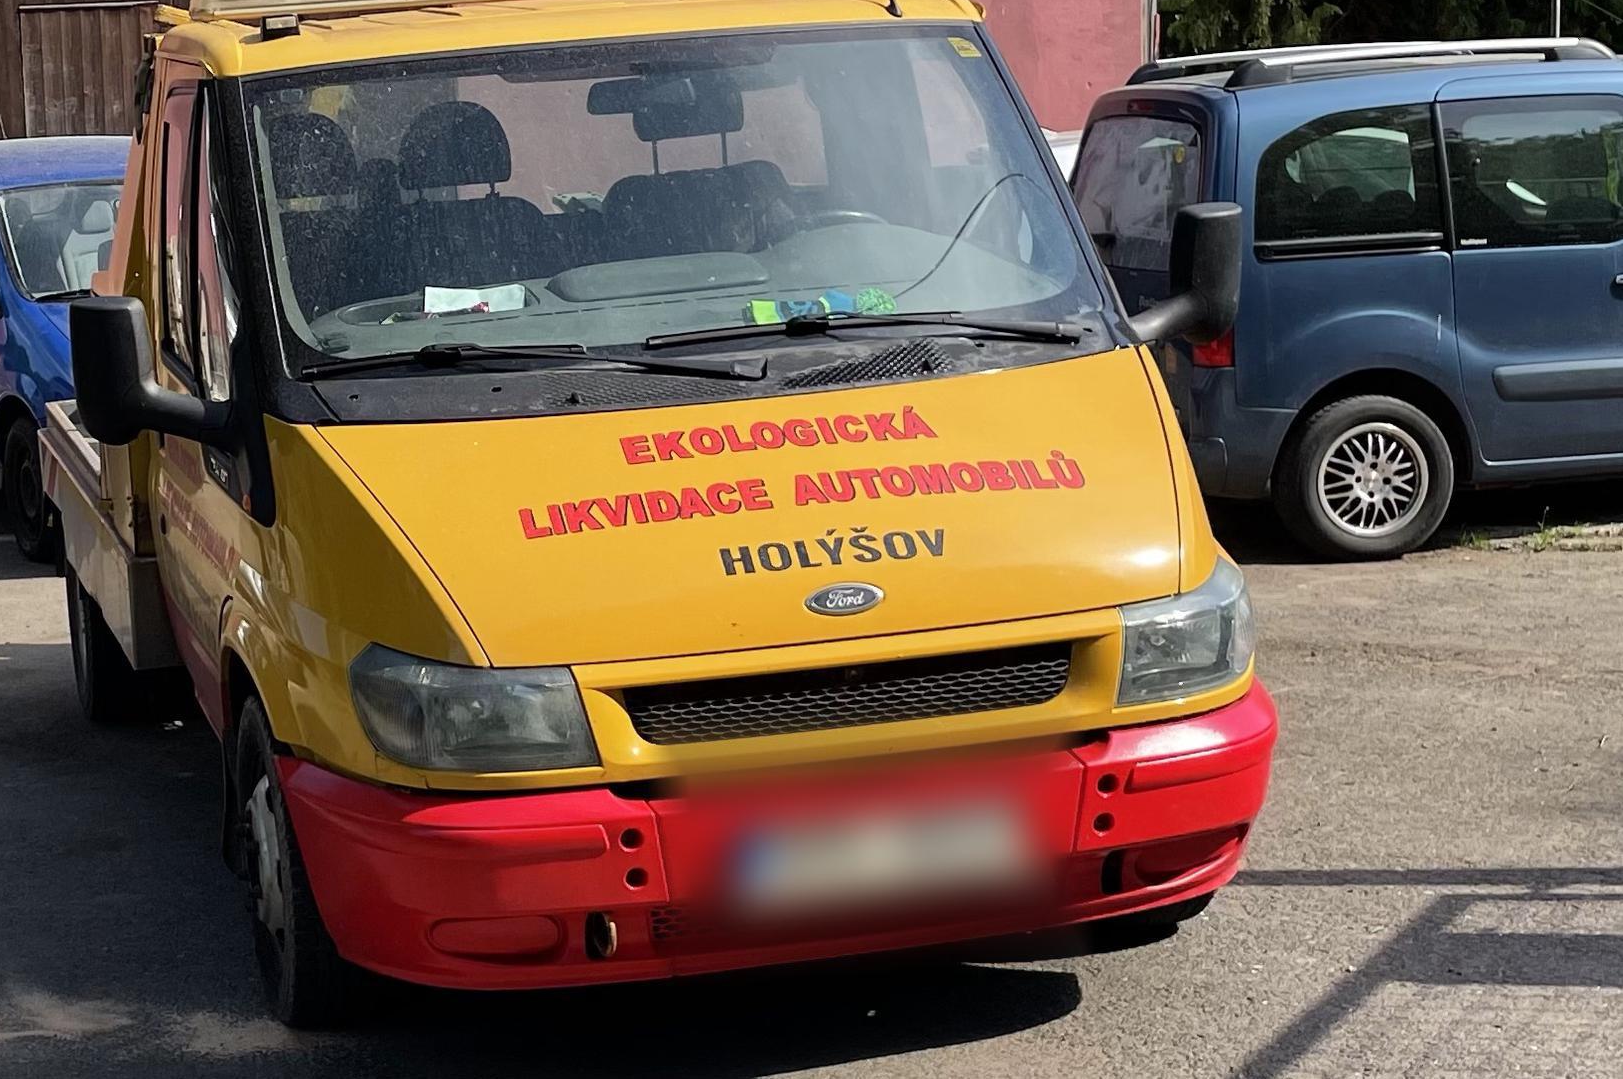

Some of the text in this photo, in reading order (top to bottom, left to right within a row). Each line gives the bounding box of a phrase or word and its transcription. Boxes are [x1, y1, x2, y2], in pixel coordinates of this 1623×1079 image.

[619, 405, 939, 465] EKOLOGICKÁ
[518, 450, 1085, 540] LIKVIDACE AUTOMOBILŮ
[719, 526, 945, 577] HOLÝŠOV
[825, 588, 866, 608] Ford
